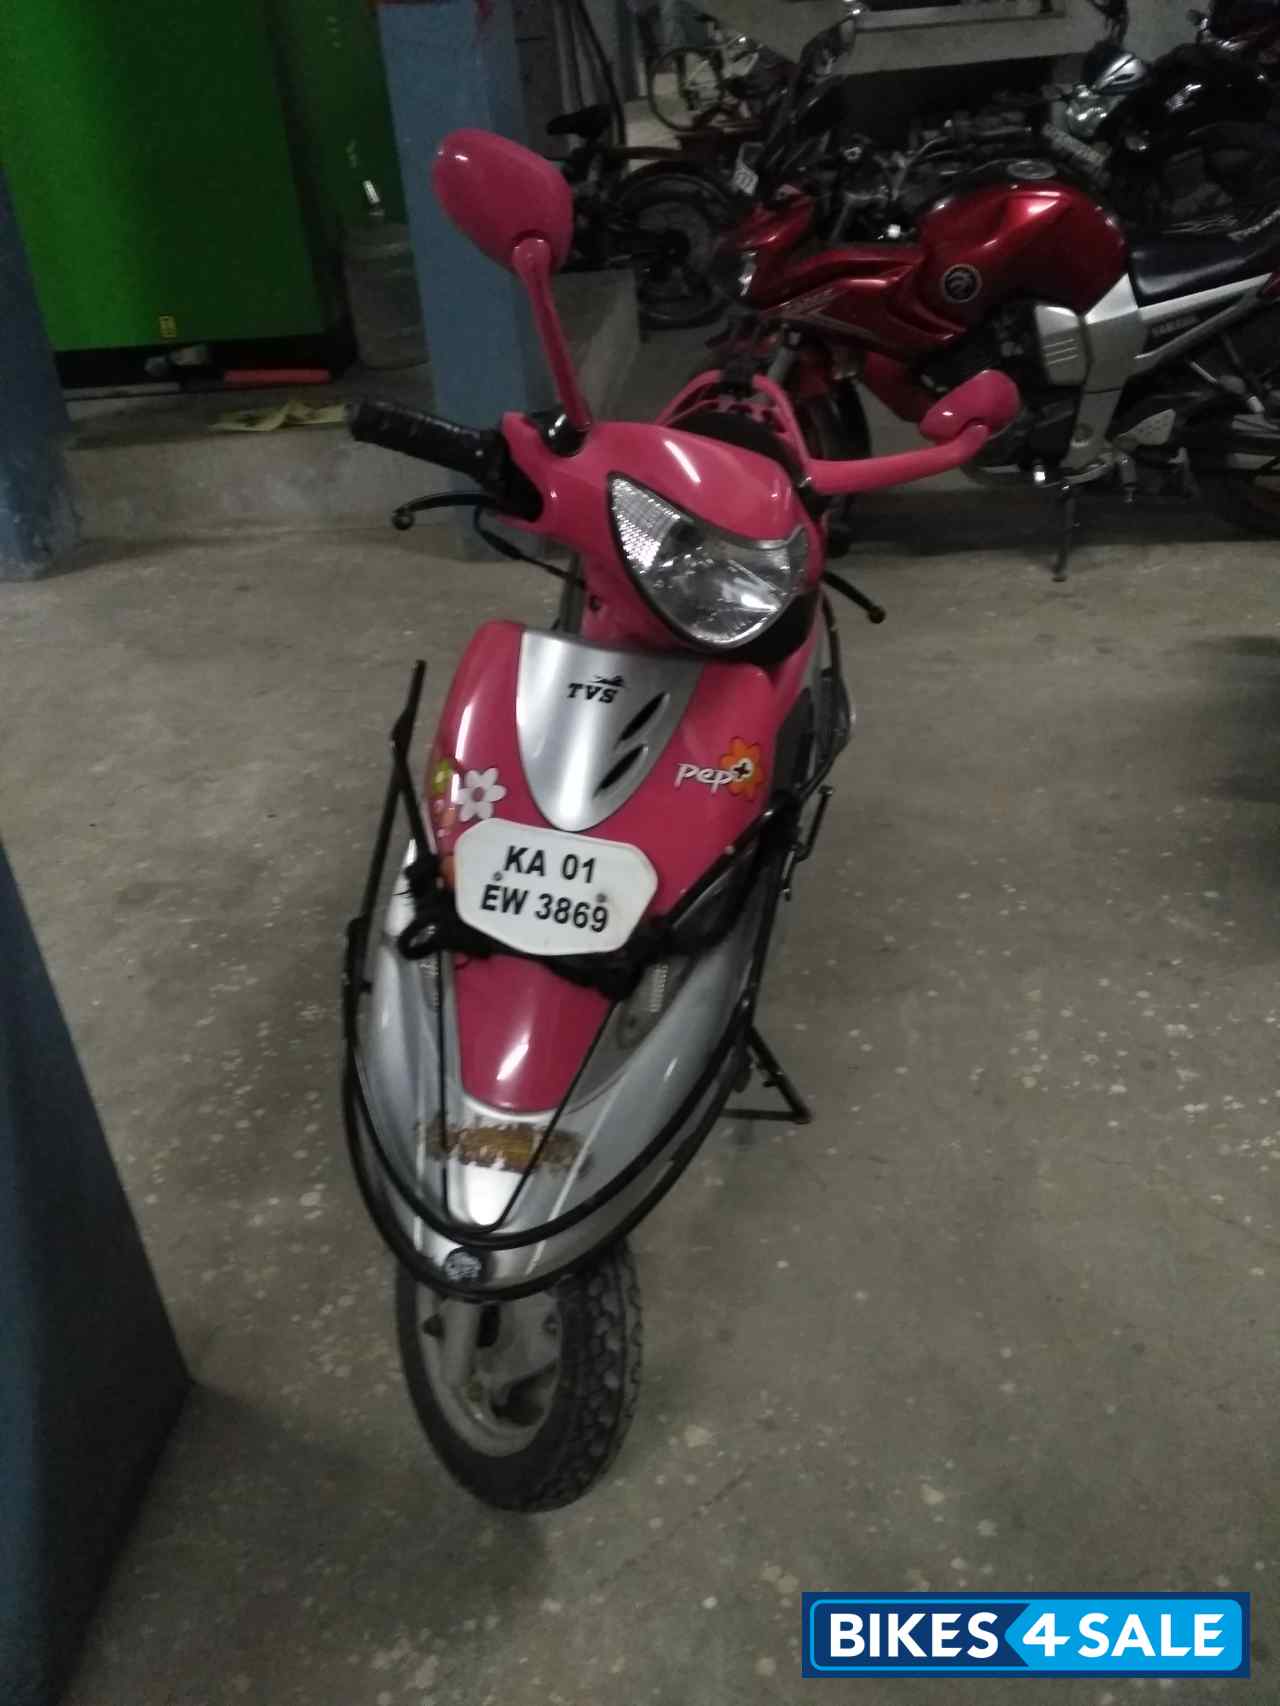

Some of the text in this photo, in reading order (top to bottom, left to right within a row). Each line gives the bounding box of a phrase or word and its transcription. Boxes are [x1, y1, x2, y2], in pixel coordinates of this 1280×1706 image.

[567, 683, 619, 704] TVS
[505, 845, 597, 884] KA 01
[480, 884, 609, 933] EW 3869
